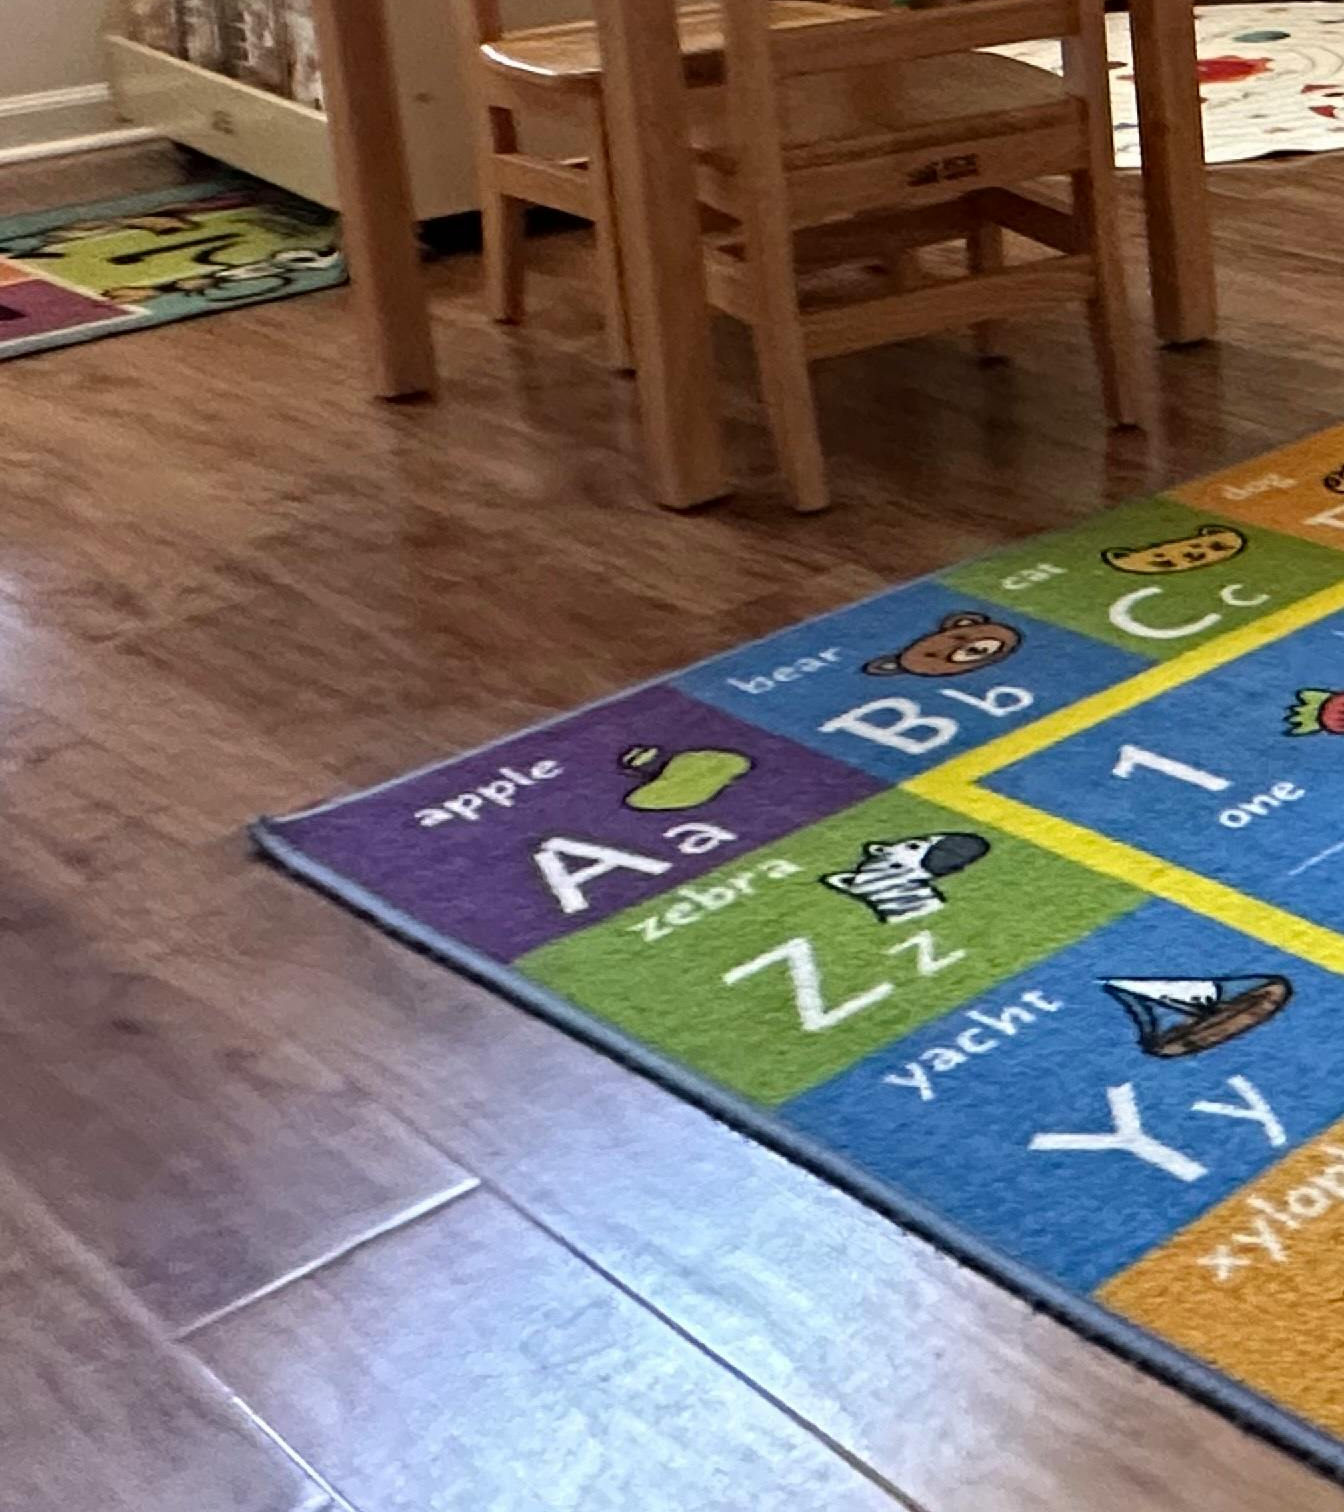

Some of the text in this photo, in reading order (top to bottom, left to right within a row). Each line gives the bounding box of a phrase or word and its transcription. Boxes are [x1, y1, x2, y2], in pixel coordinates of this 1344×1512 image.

[1000, 562, 1067, 590] cat
[1109, 584, 1270, 639] Cc
[726, 644, 842, 695] bear
[817, 686, 1034, 755] Bb
[413, 753, 565, 830] apple
[1112, 744, 1231, 791] 1
[1219, 778, 1306, 830] one
[533, 820, 738, 915] Aa
[626, 855, 806, 944] zebra
[722, 928, 968, 1034] Zz
[884, 987, 1067, 1102] yacht
[1029, 1074, 1289, 1185] Yy
